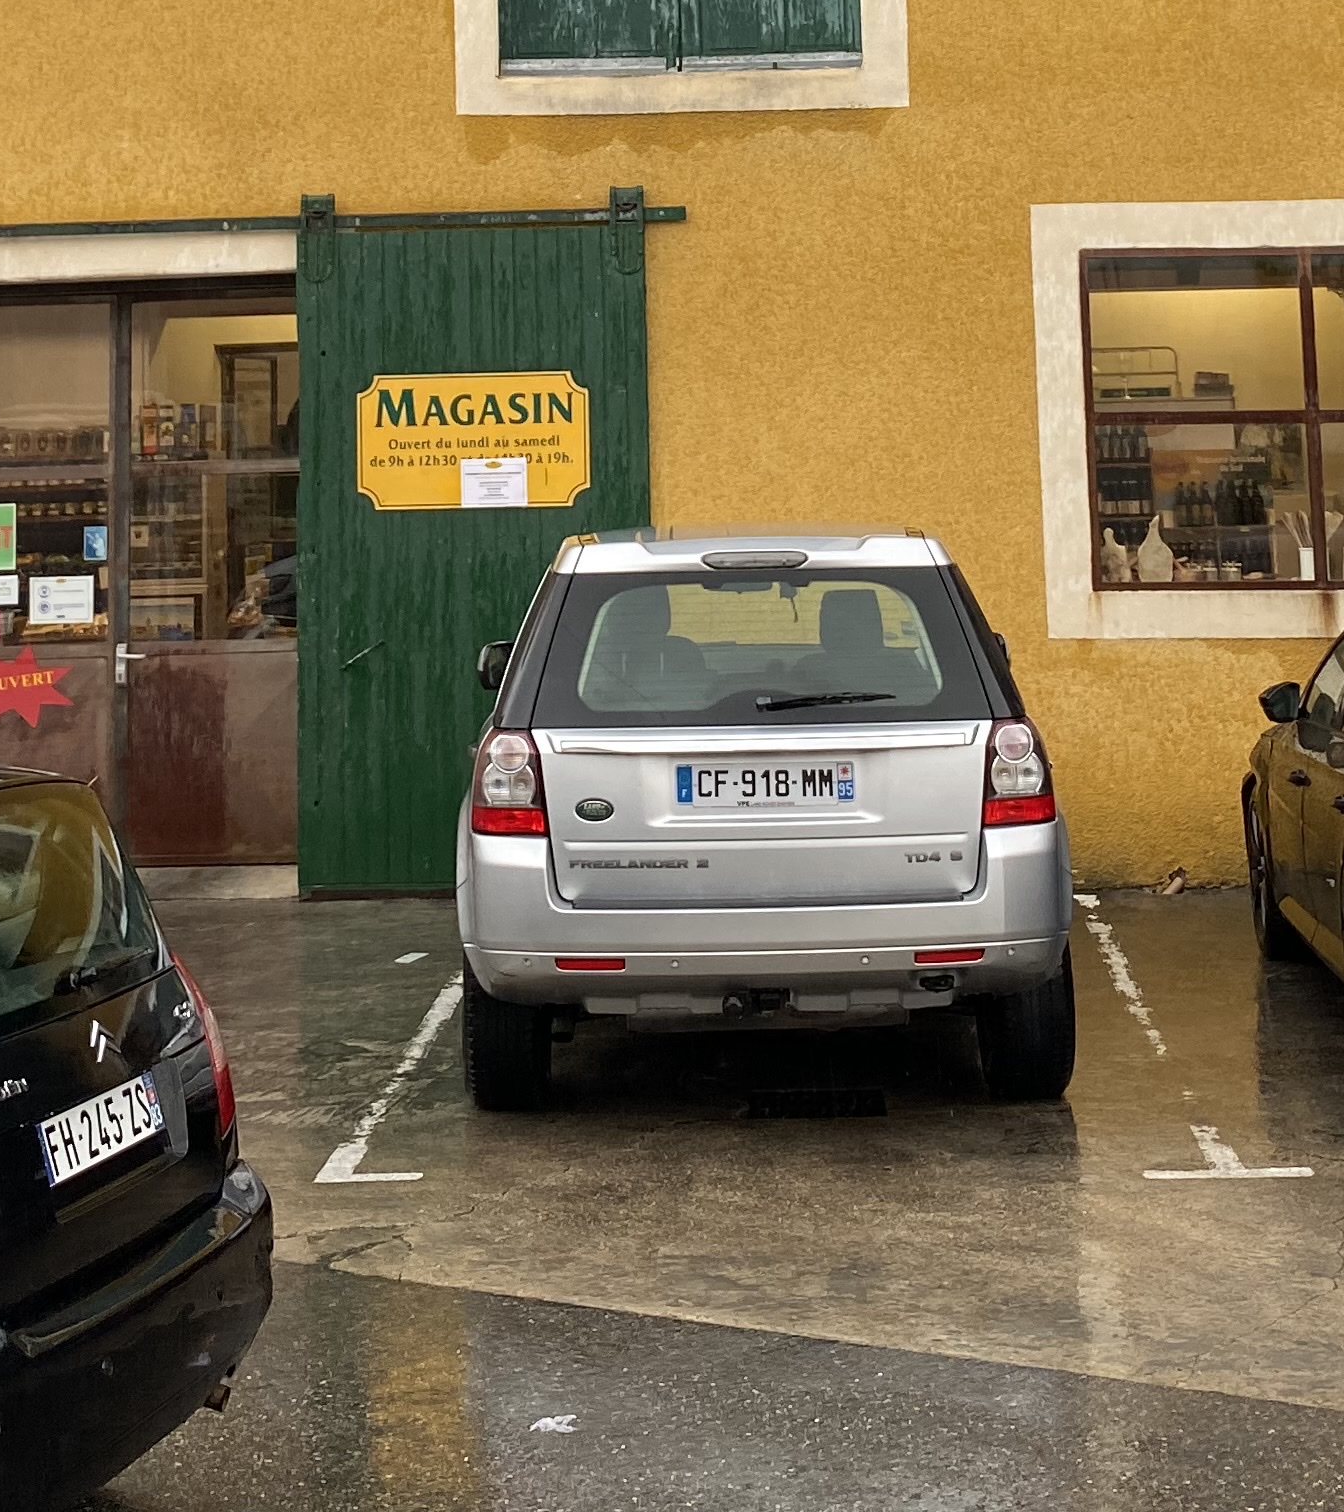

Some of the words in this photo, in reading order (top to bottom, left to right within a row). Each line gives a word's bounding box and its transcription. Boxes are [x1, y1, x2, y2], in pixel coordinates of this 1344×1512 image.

[375, 389, 574, 427] MAGASIN
[388, 438, 431, 450] Ouvert
[436, 437, 452, 449] du
[457, 436, 489, 448] lundi
[494, 437, 510, 449] au
[514, 435, 560, 447] samedi
[370, 456, 386, 467] de
[389, 456, 404, 467] 9h
[408, 455, 414, 467] à
[419, 454, 457, 467] 12h30
[536, 452, 543, 464] à
[698, 769, 833, 798] CF-918-MM
[838, 782, 853, 797] 95
[569, 859, 688, 869] FREELANDER
[904, 851, 941, 863] TD4
[45, 1083, 152, 1177] FH-245-ZS
